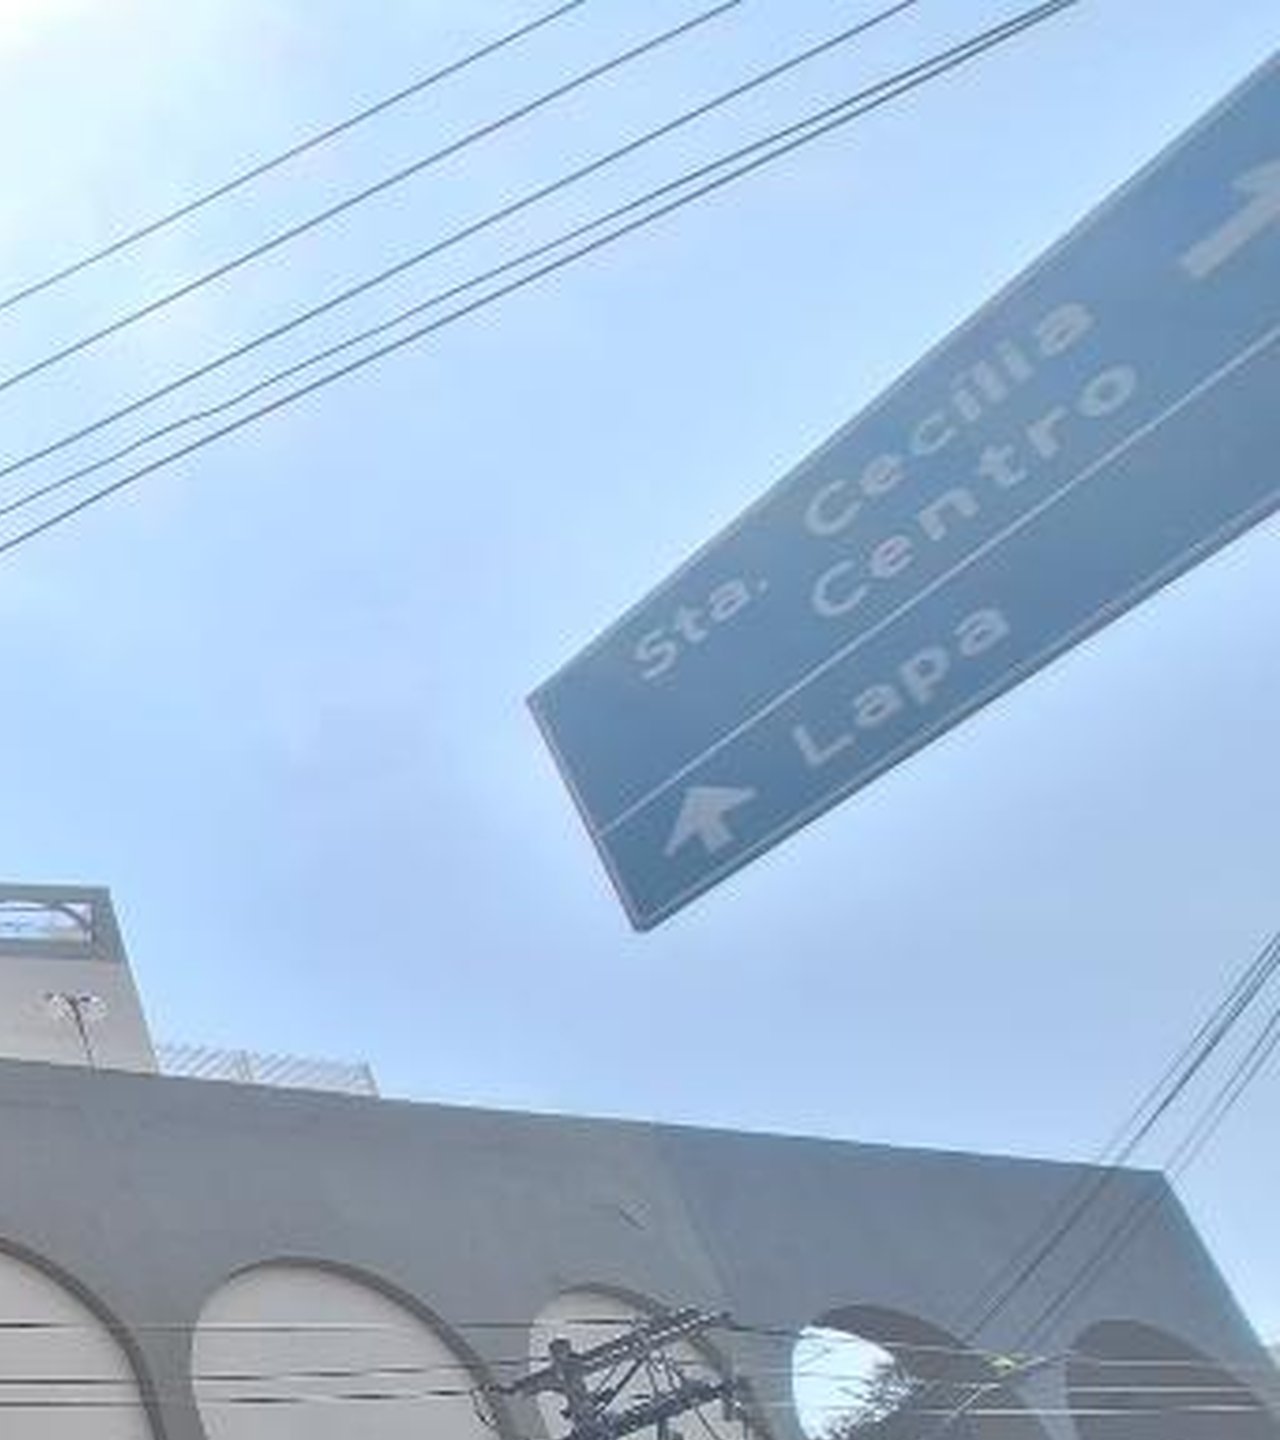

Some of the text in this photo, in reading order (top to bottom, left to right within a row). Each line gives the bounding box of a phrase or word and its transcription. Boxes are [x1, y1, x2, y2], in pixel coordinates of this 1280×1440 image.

[813, 365, 1137, 618] Centro
[637, 578, 768, 681] Sta.
[792, 608, 1010, 766] Lapa
